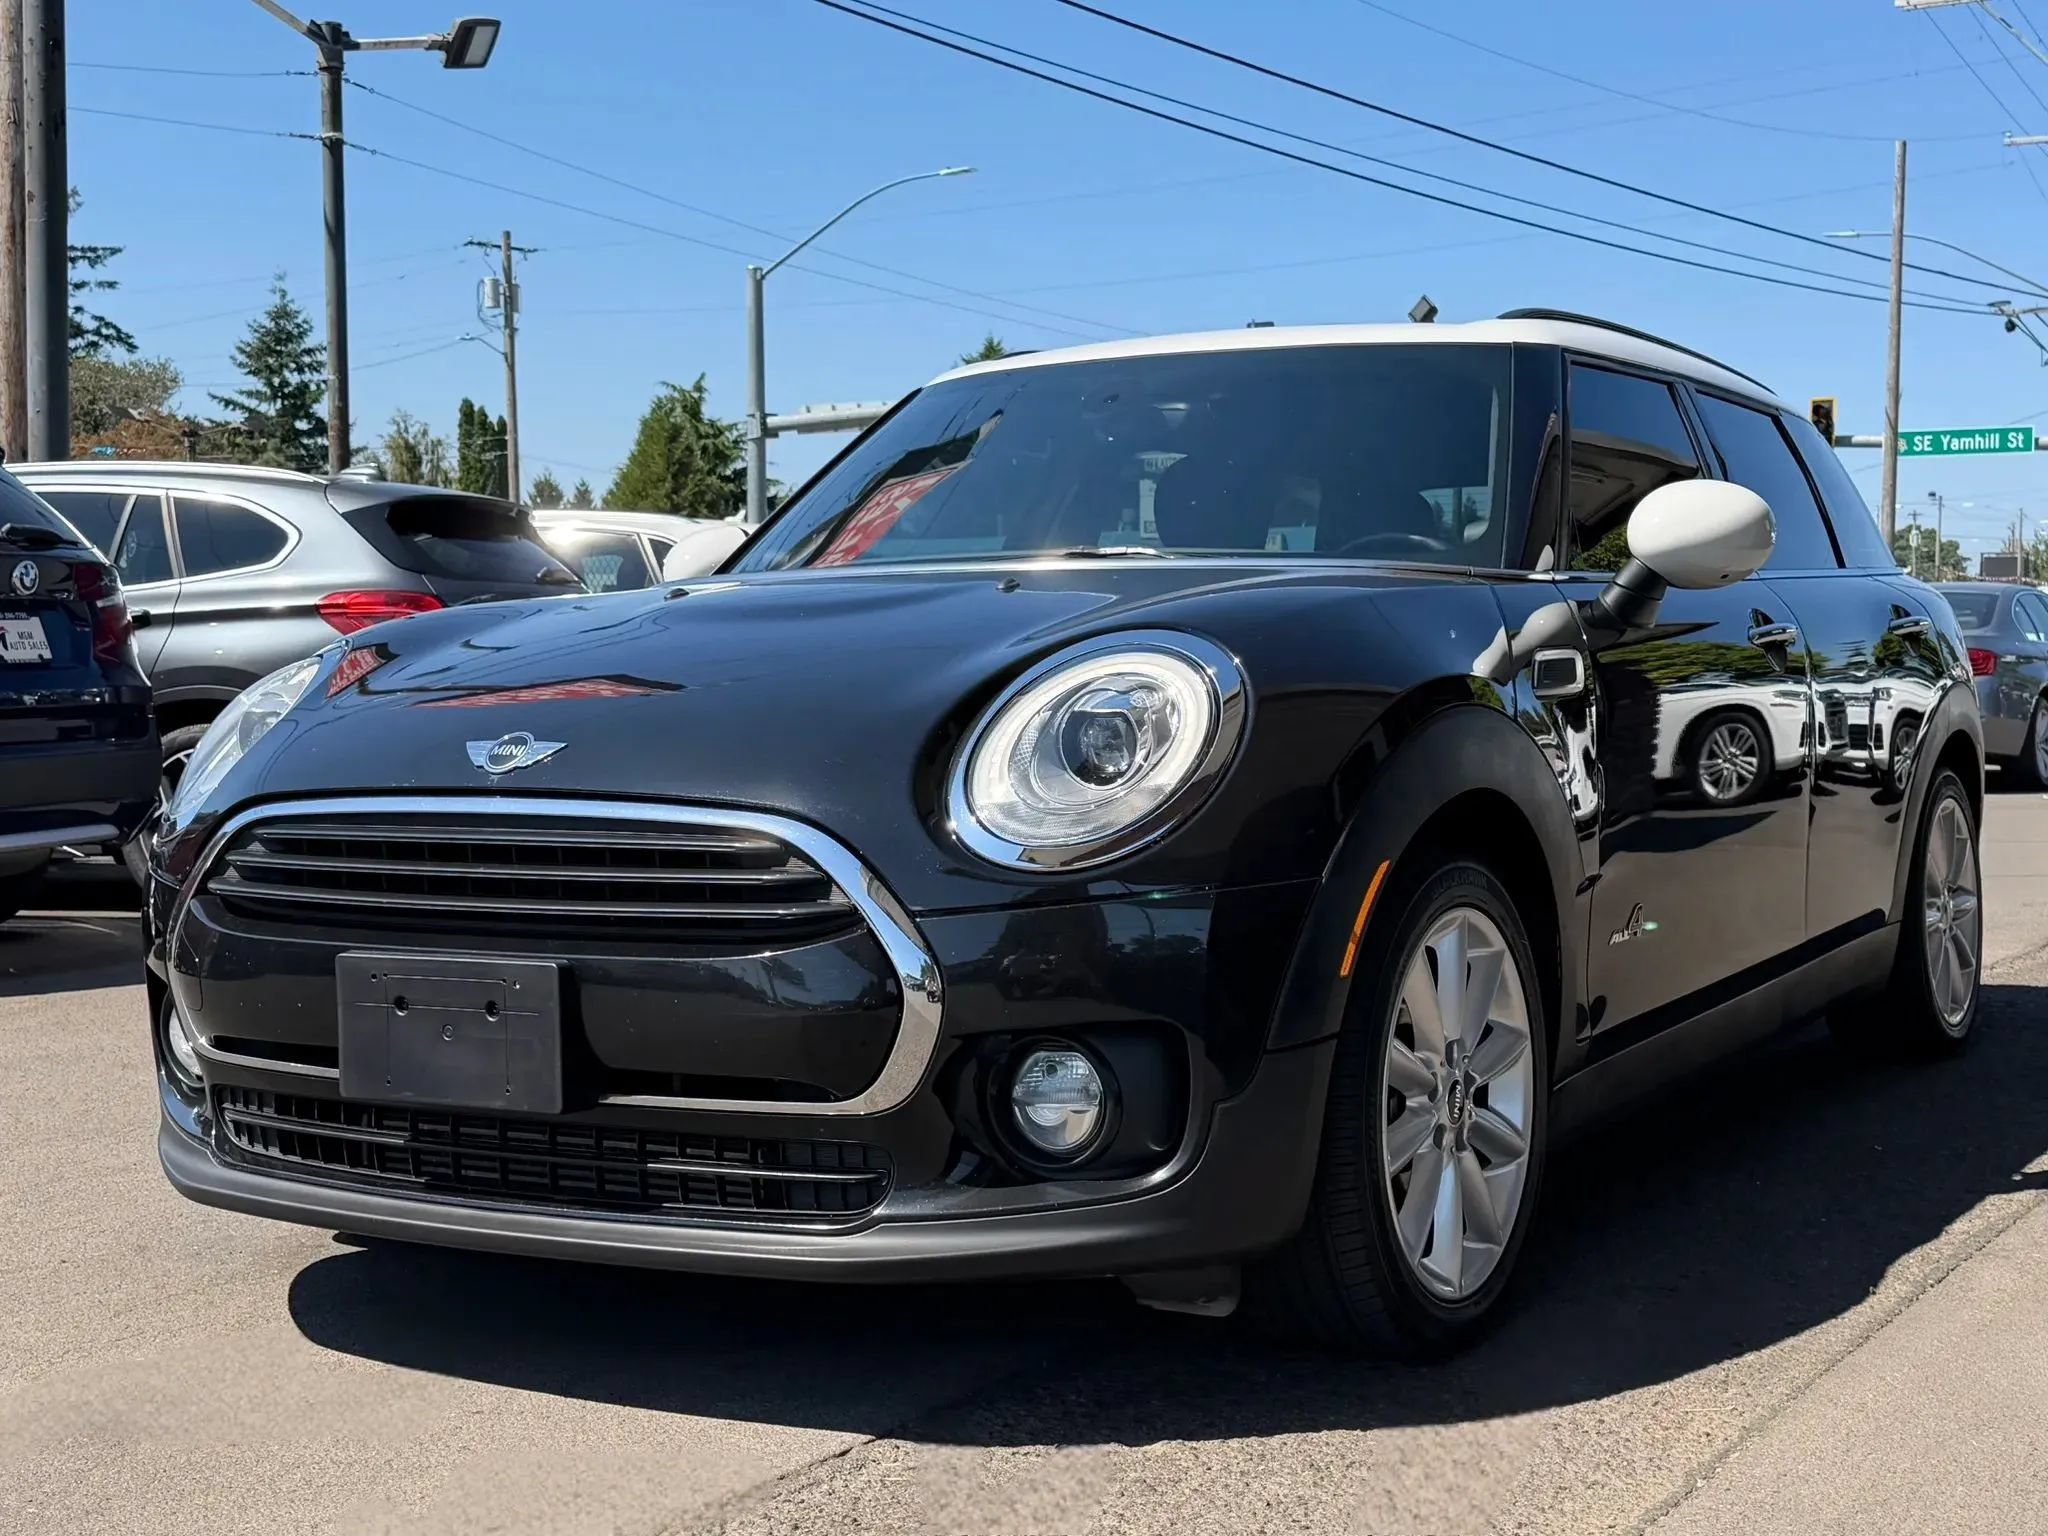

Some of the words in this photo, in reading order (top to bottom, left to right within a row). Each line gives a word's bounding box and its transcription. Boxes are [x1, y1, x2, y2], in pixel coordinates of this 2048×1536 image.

[1913, 435, 1933, 452] SE
[1940, 433, 1999, 450] Yamhill
[2007, 432, 2025, 448] St
[10, 641, 27, 650] AUTO
[27, 641, 49, 650] SALES
[490, 744, 526, 756] MINI
[1453, 1084, 1461, 1118] MINI
